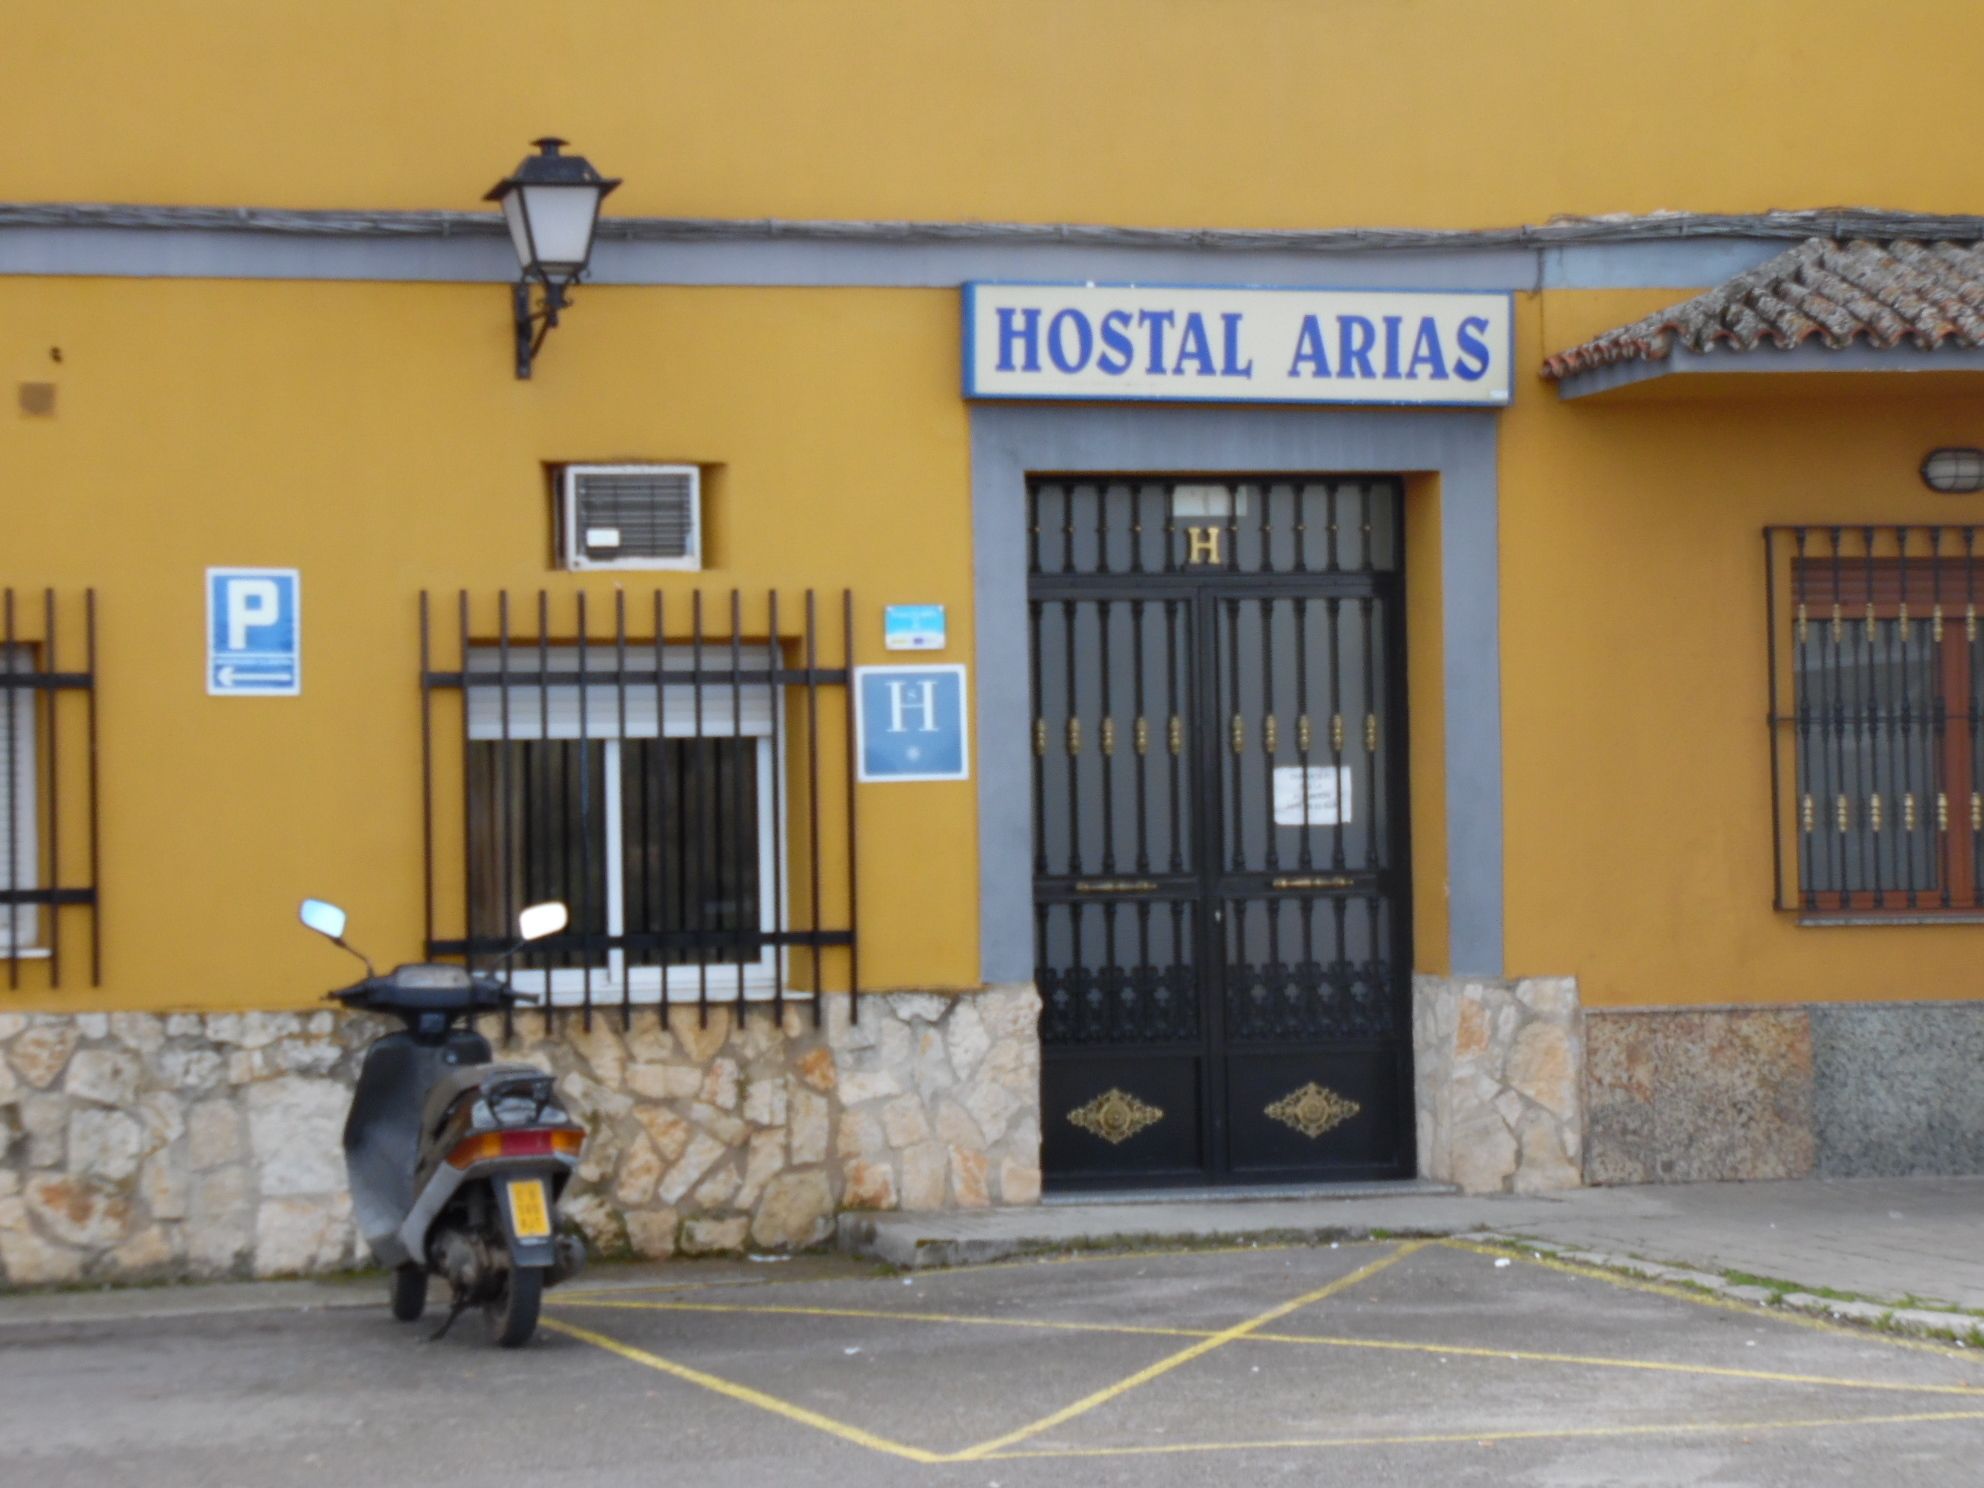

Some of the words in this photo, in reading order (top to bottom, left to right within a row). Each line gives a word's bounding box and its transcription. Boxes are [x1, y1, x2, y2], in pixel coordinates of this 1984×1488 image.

[995, 306, 1254, 378] HOSTAL
[1287, 314, 1491, 381] ARIAS
[1187, 526, 1221, 565] H
[227, 579, 279, 650] P
